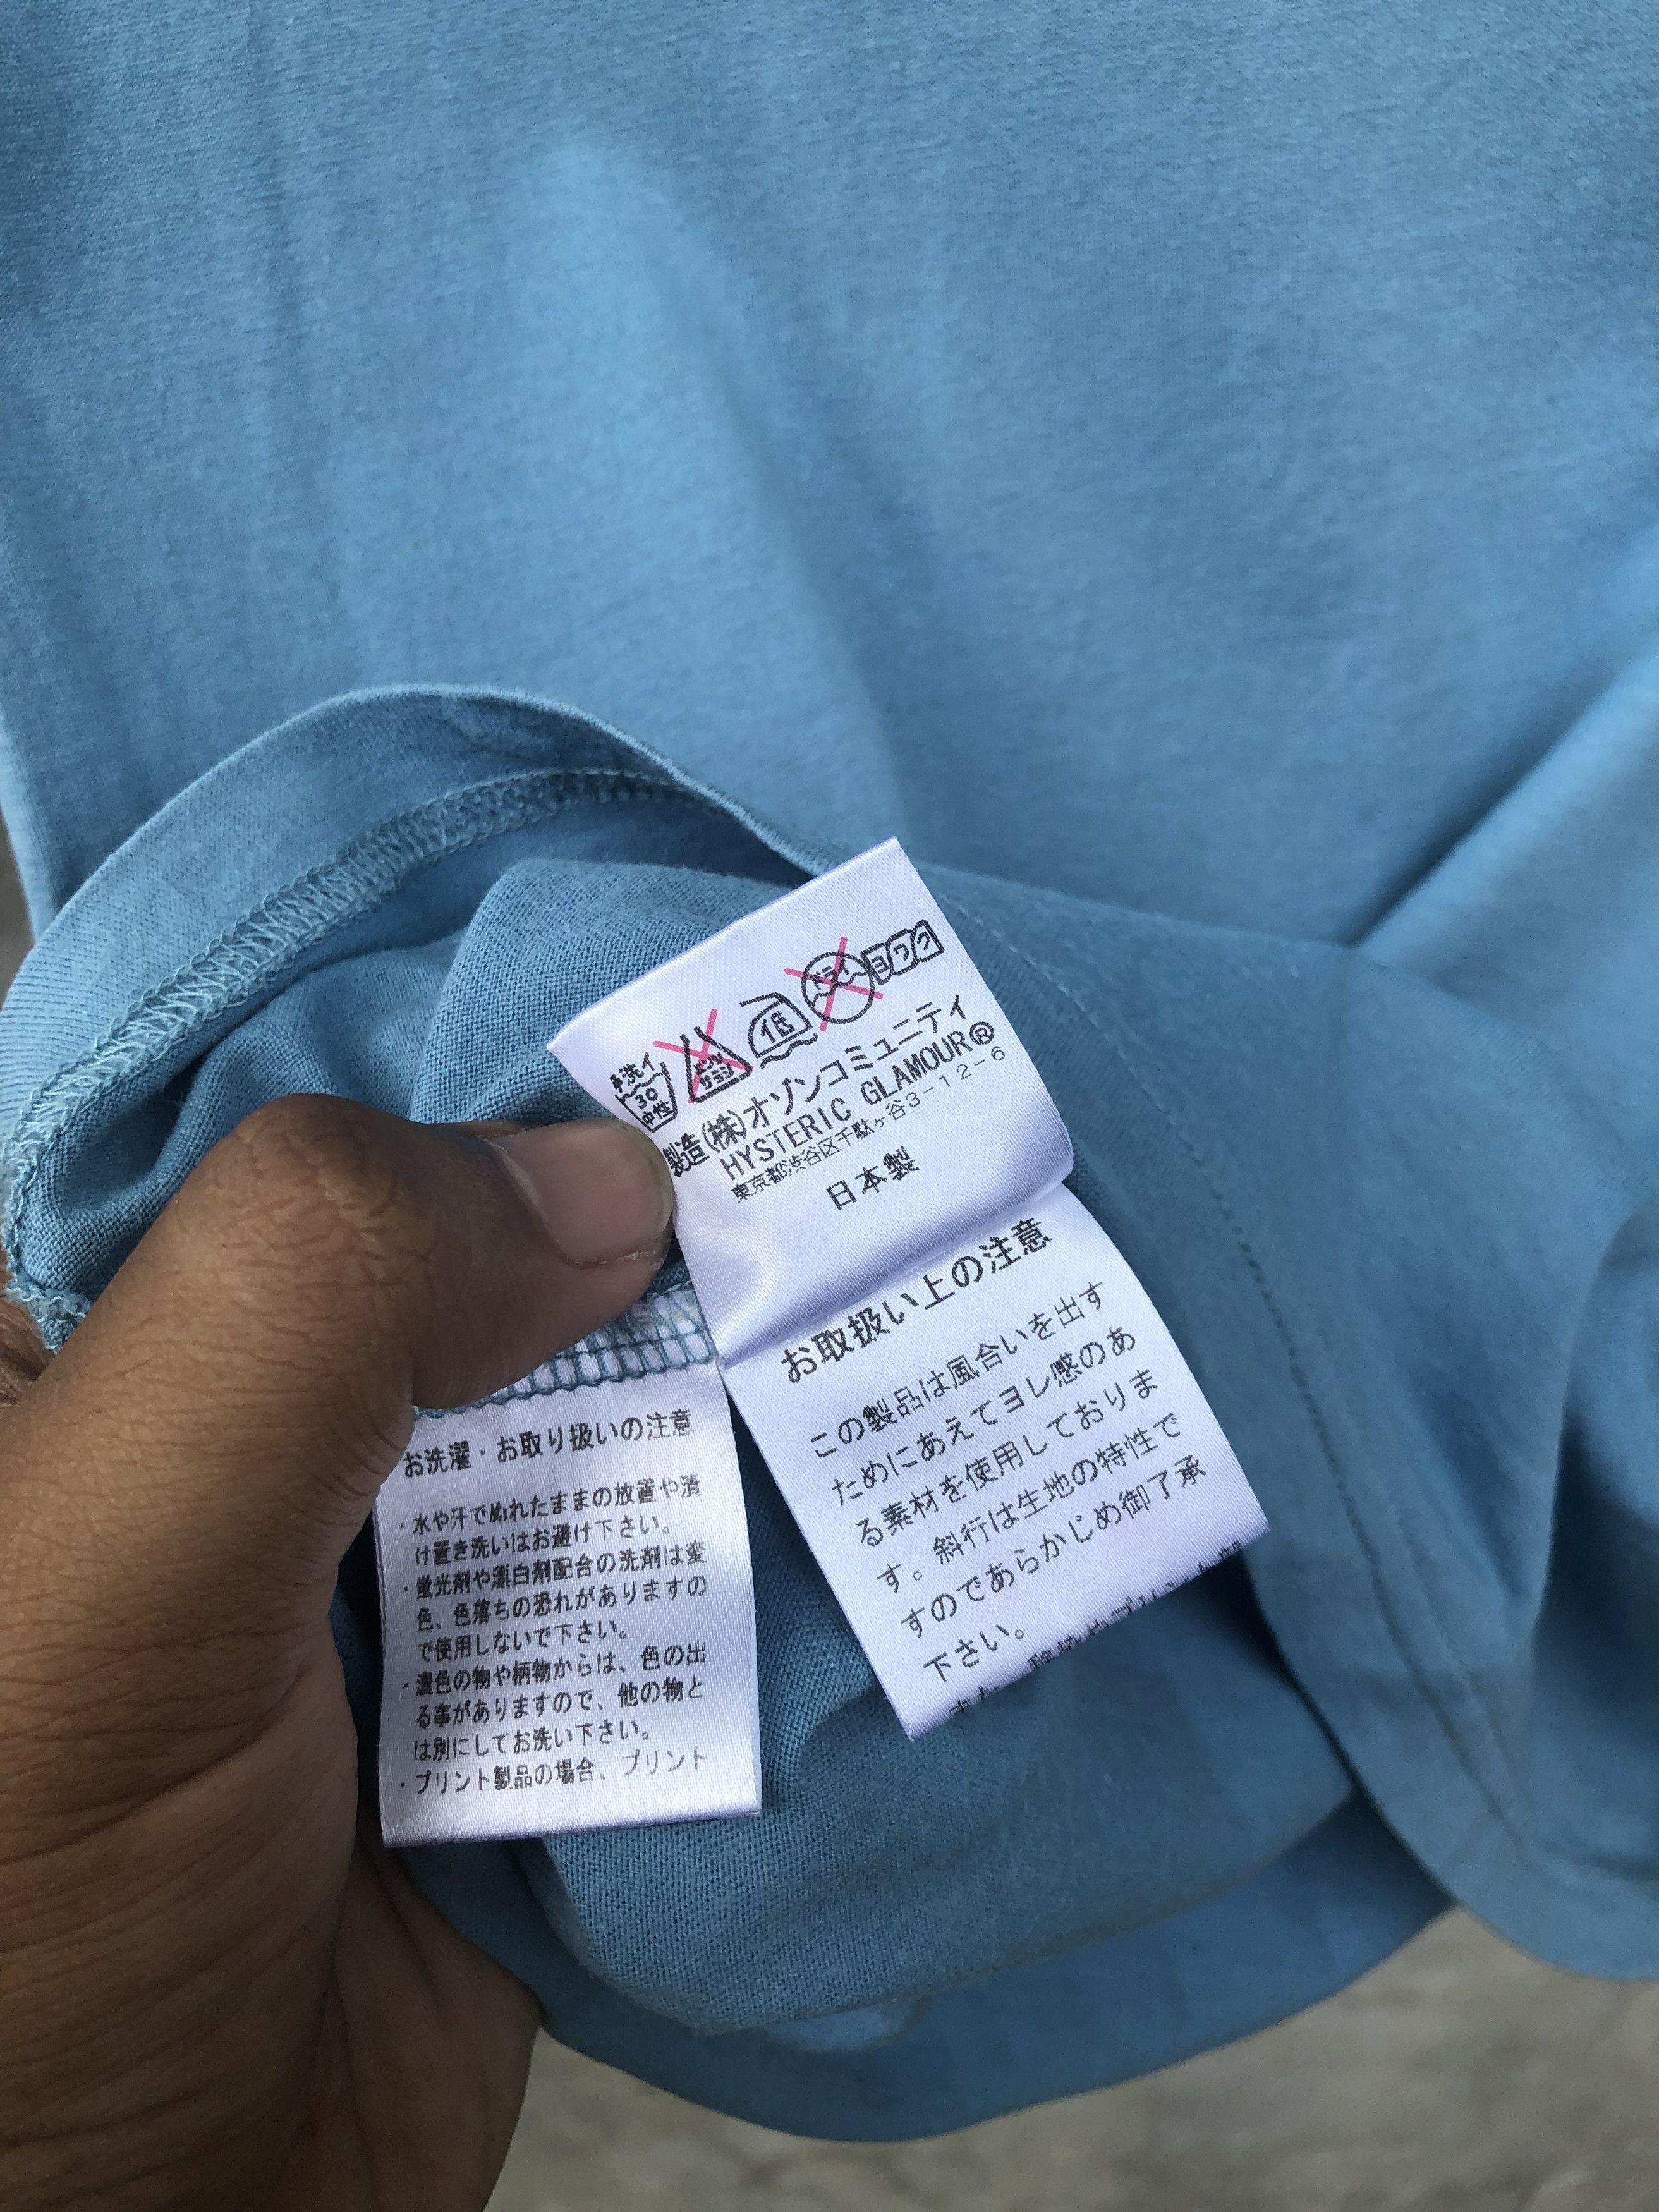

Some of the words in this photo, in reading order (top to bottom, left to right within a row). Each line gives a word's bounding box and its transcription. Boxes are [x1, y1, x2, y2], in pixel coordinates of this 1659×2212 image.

[872, 928, 932, 976] ヨワク
[808, 955, 851, 990] ドライ
[758, 1011, 795, 1042] 低
[633, 1086, 659, 1110] 30
[641, 1102, 672, 1127] 中性
[720, 1098, 851, 1180] HYSTERIC
[826, 1146, 920, 1210] 日本製
